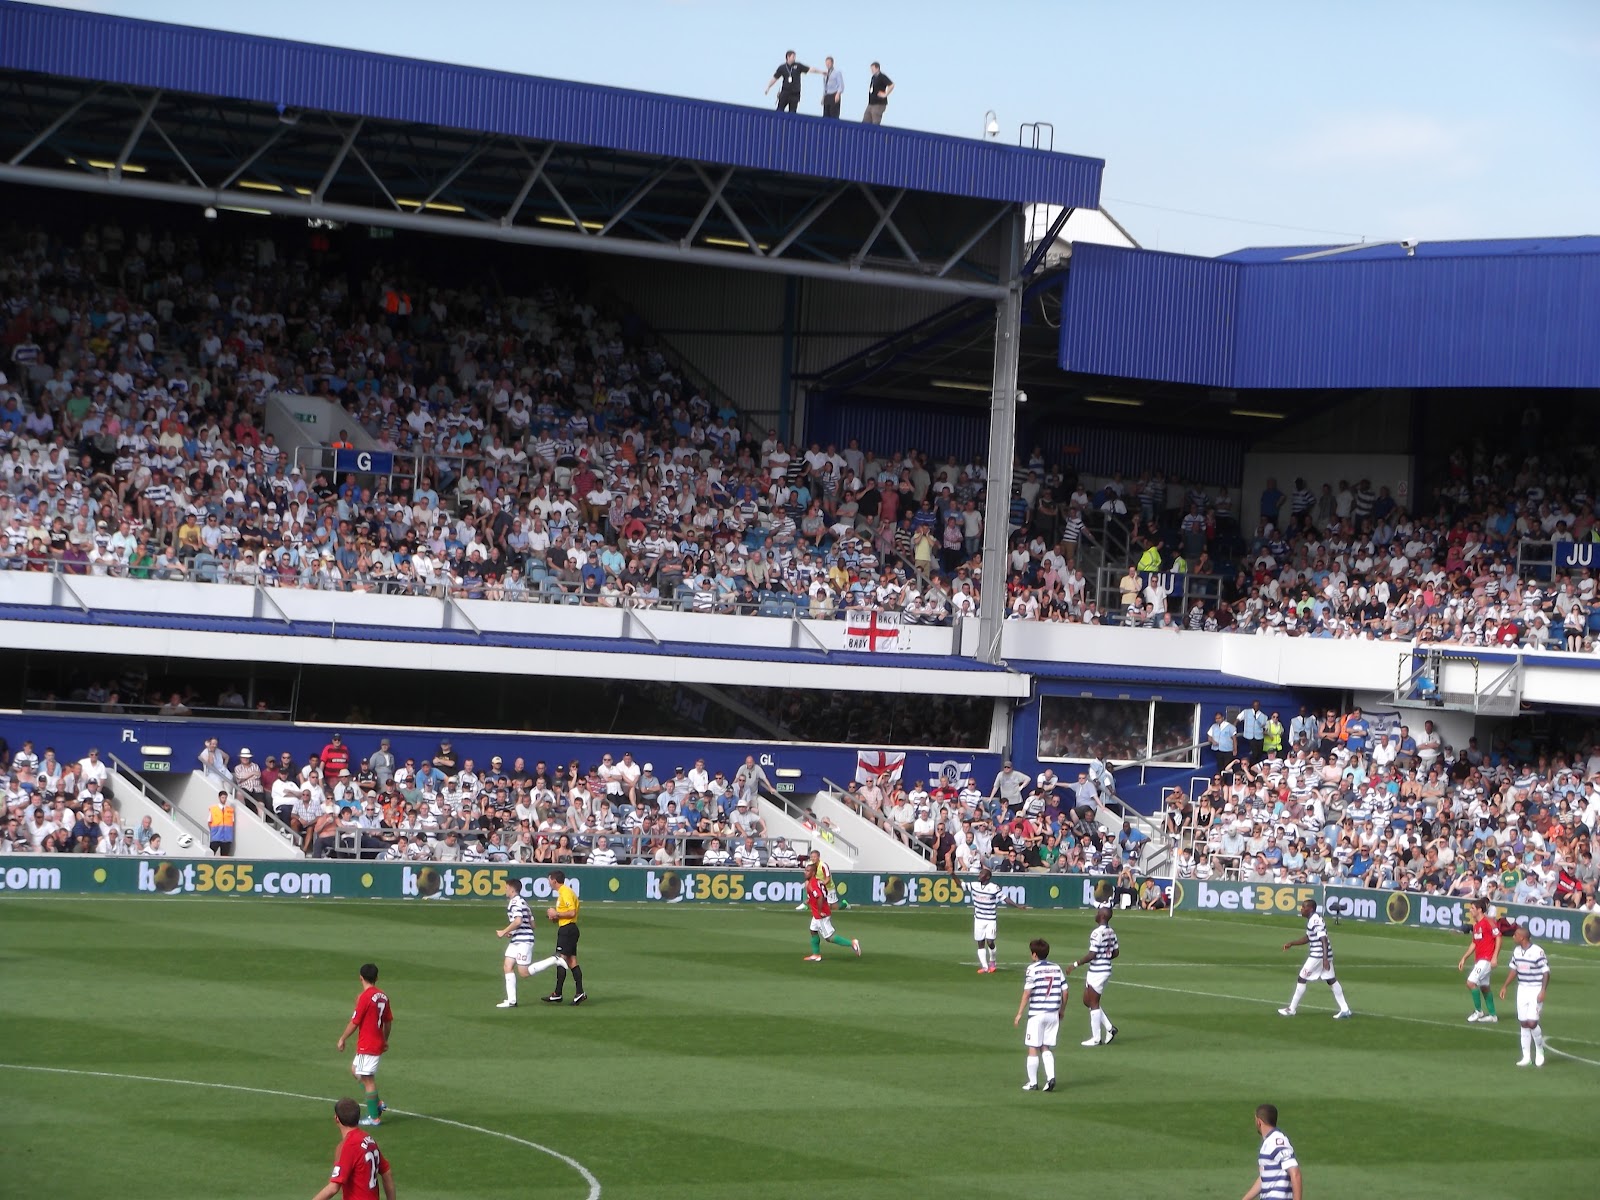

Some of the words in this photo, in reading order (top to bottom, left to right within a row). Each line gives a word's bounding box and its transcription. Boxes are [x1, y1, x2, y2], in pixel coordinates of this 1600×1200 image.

[357, 452, 371, 471] G
[1567, 543, 1592, 566] JU
[848, 638, 867, 648] BABY
[122, 729, 138, 742] FL
[760, 753, 774, 766] GL
[0, 867, 61, 890] om
[138, 861, 331, 895] bt365.com
[646, 870, 803, 903] bt365.com
[1043, 976, 1054, 998] 7
[377, 1002, 386, 1028] 7
